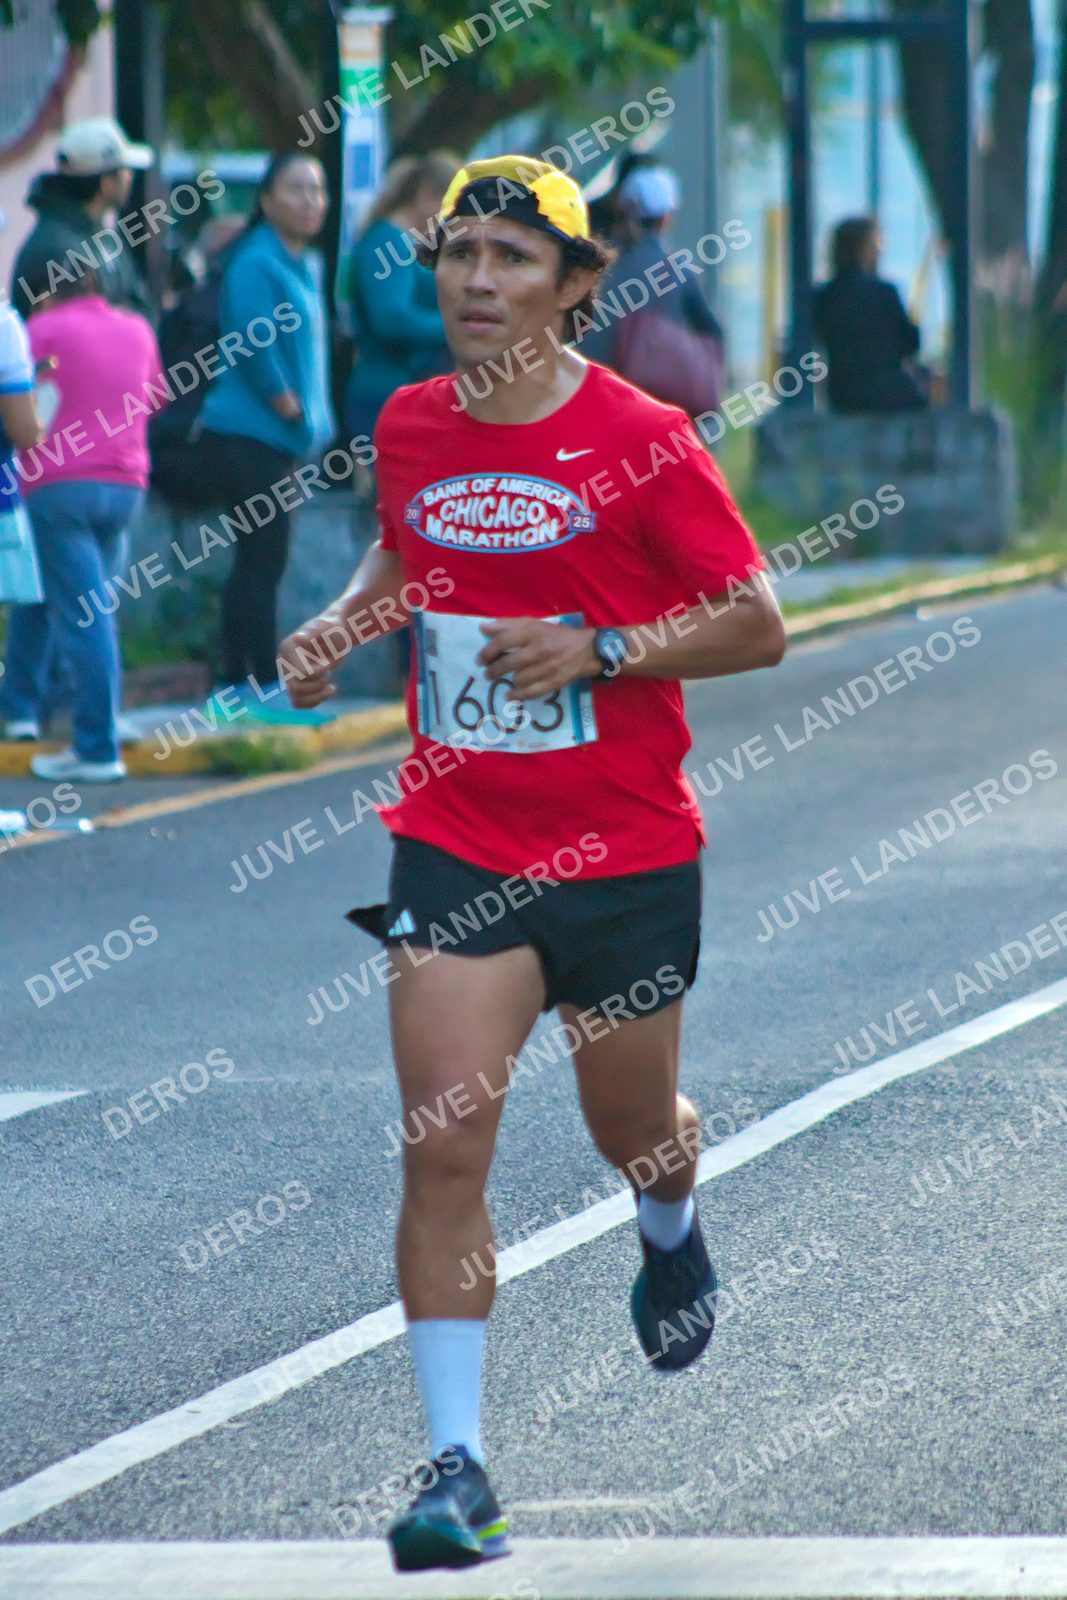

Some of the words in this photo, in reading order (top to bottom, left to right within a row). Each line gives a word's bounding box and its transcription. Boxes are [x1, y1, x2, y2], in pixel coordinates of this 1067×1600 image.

[422, 479, 469, 506] BANK
[471, 478, 496, 493] OF
[496, 477, 572, 511] AMERICA
[439, 496, 545, 528] CHICAGO
[573, 516, 591, 528] 25
[426, 514, 559, 548] MARATHON
